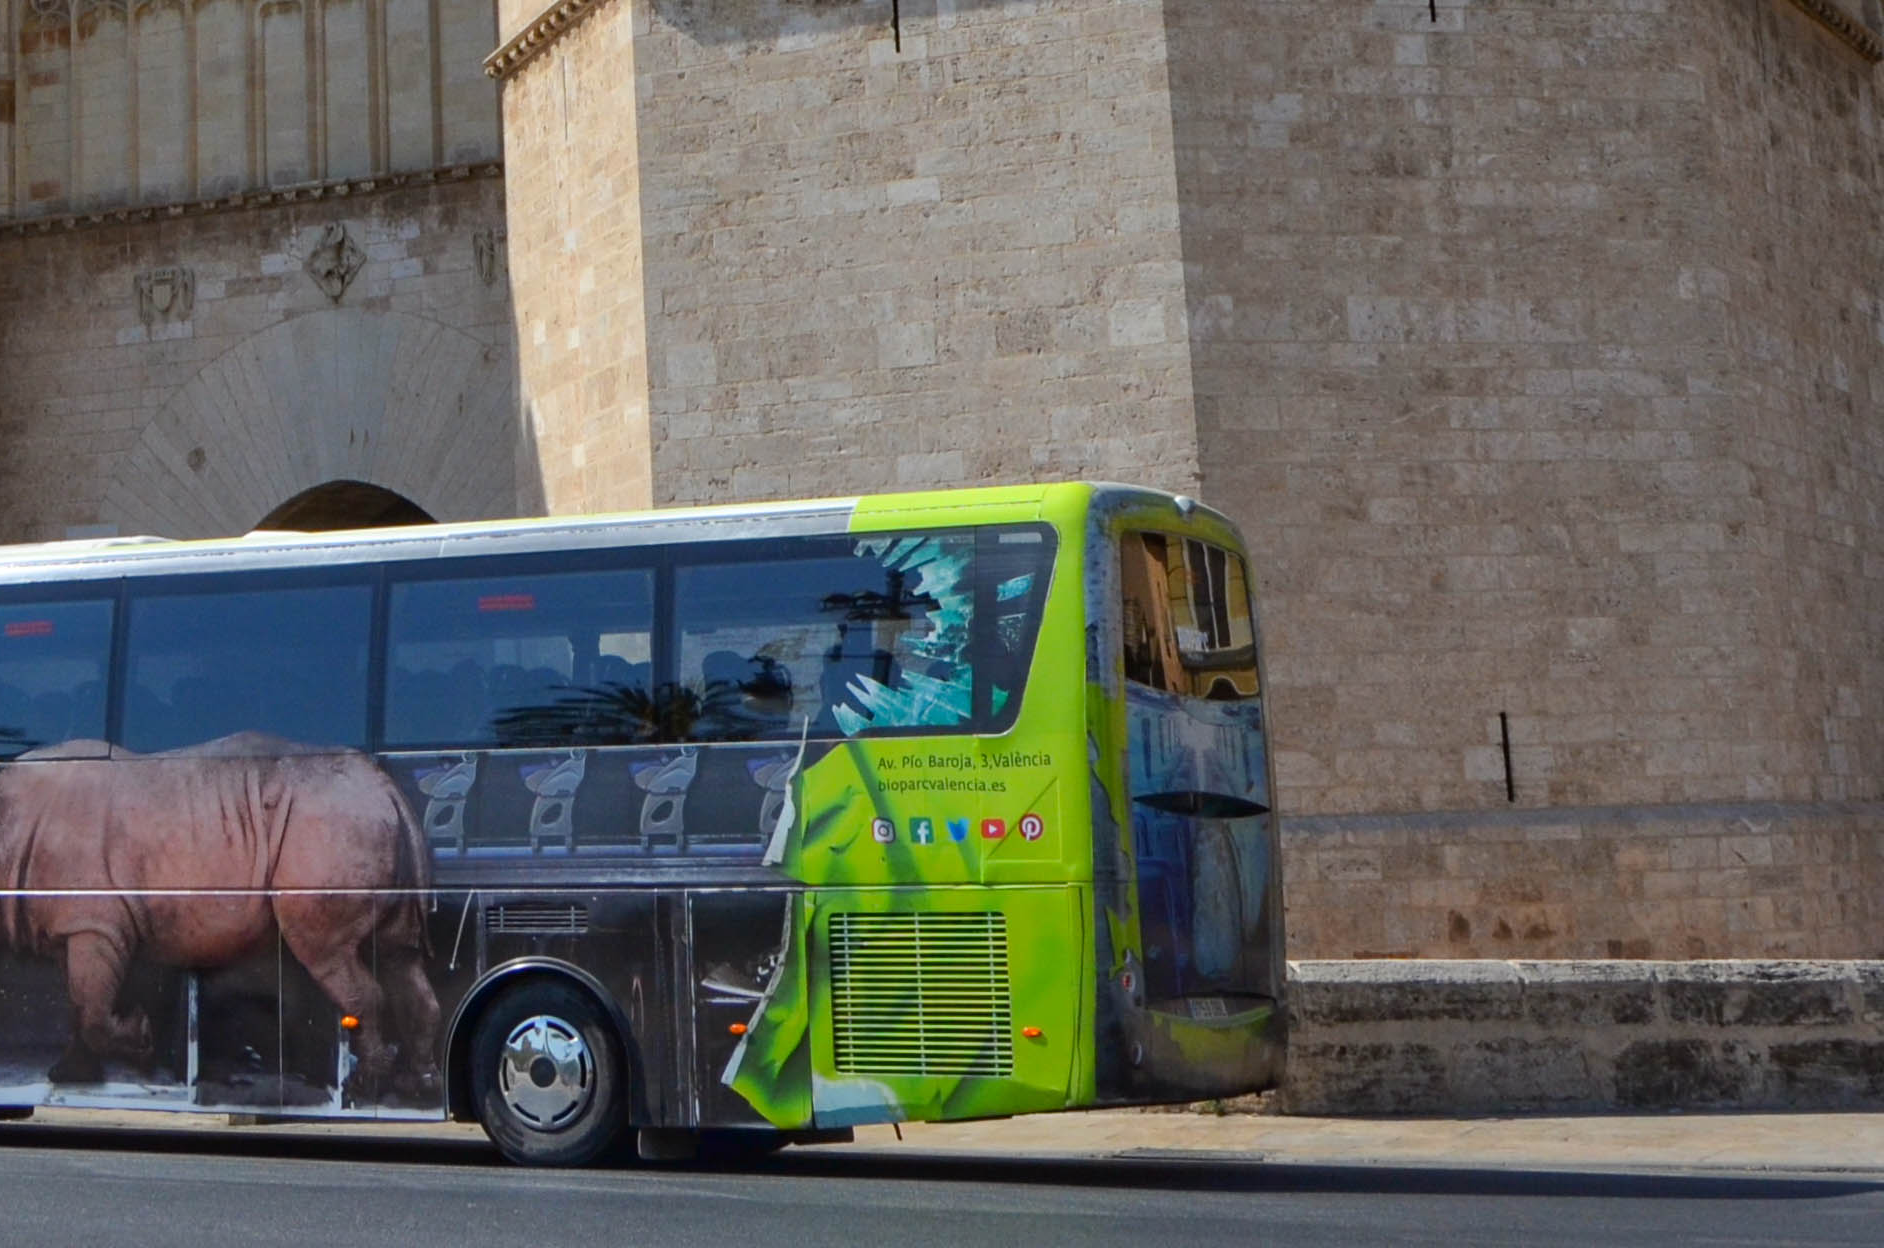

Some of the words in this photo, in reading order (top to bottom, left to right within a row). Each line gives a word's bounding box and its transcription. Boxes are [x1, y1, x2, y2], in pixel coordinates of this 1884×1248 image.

[878, 756, 897, 769] Av.
[902, 754, 923, 768] Pío
[928, 753, 977, 770] Baroja,
[878, 777, 1007, 793] bioparcvalencia.es
